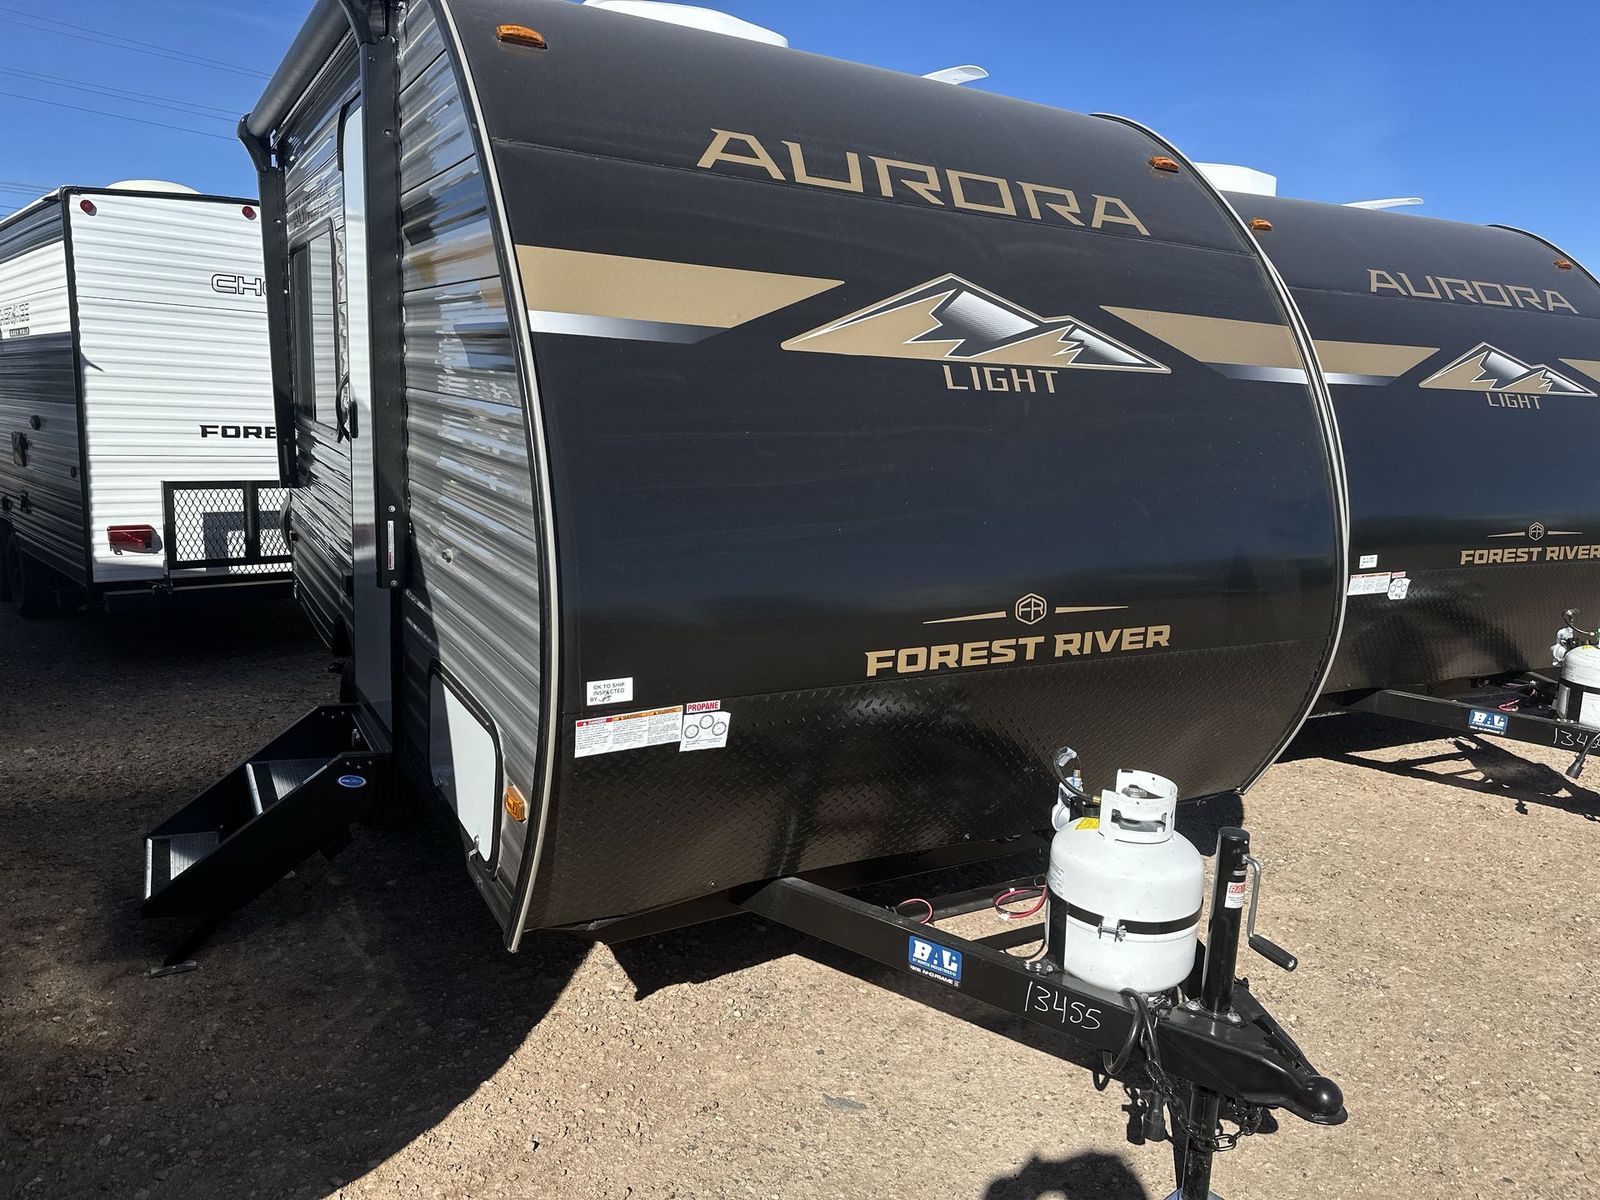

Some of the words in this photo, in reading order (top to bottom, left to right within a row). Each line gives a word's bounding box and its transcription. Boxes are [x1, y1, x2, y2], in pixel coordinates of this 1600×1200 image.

[696, 127, 1152, 236] AURORA
[211, 273, 267, 296] CH
[1366, 268, 1580, 315] AURORA
[942, 364, 1059, 394] LIGHT
[1485, 391, 1541, 410] LIGHT
[199, 424, 277, 439] FORE
[1460, 547, 1543, 566] FOREST
[1545, 544, 1600, 561] RIVER
[864, 635, 1046, 678] FOREST
[1053, 624, 1172, 658] RIVER
[687, 701, 719, 712] PROPANE
[913, 939, 958, 972] BAL
